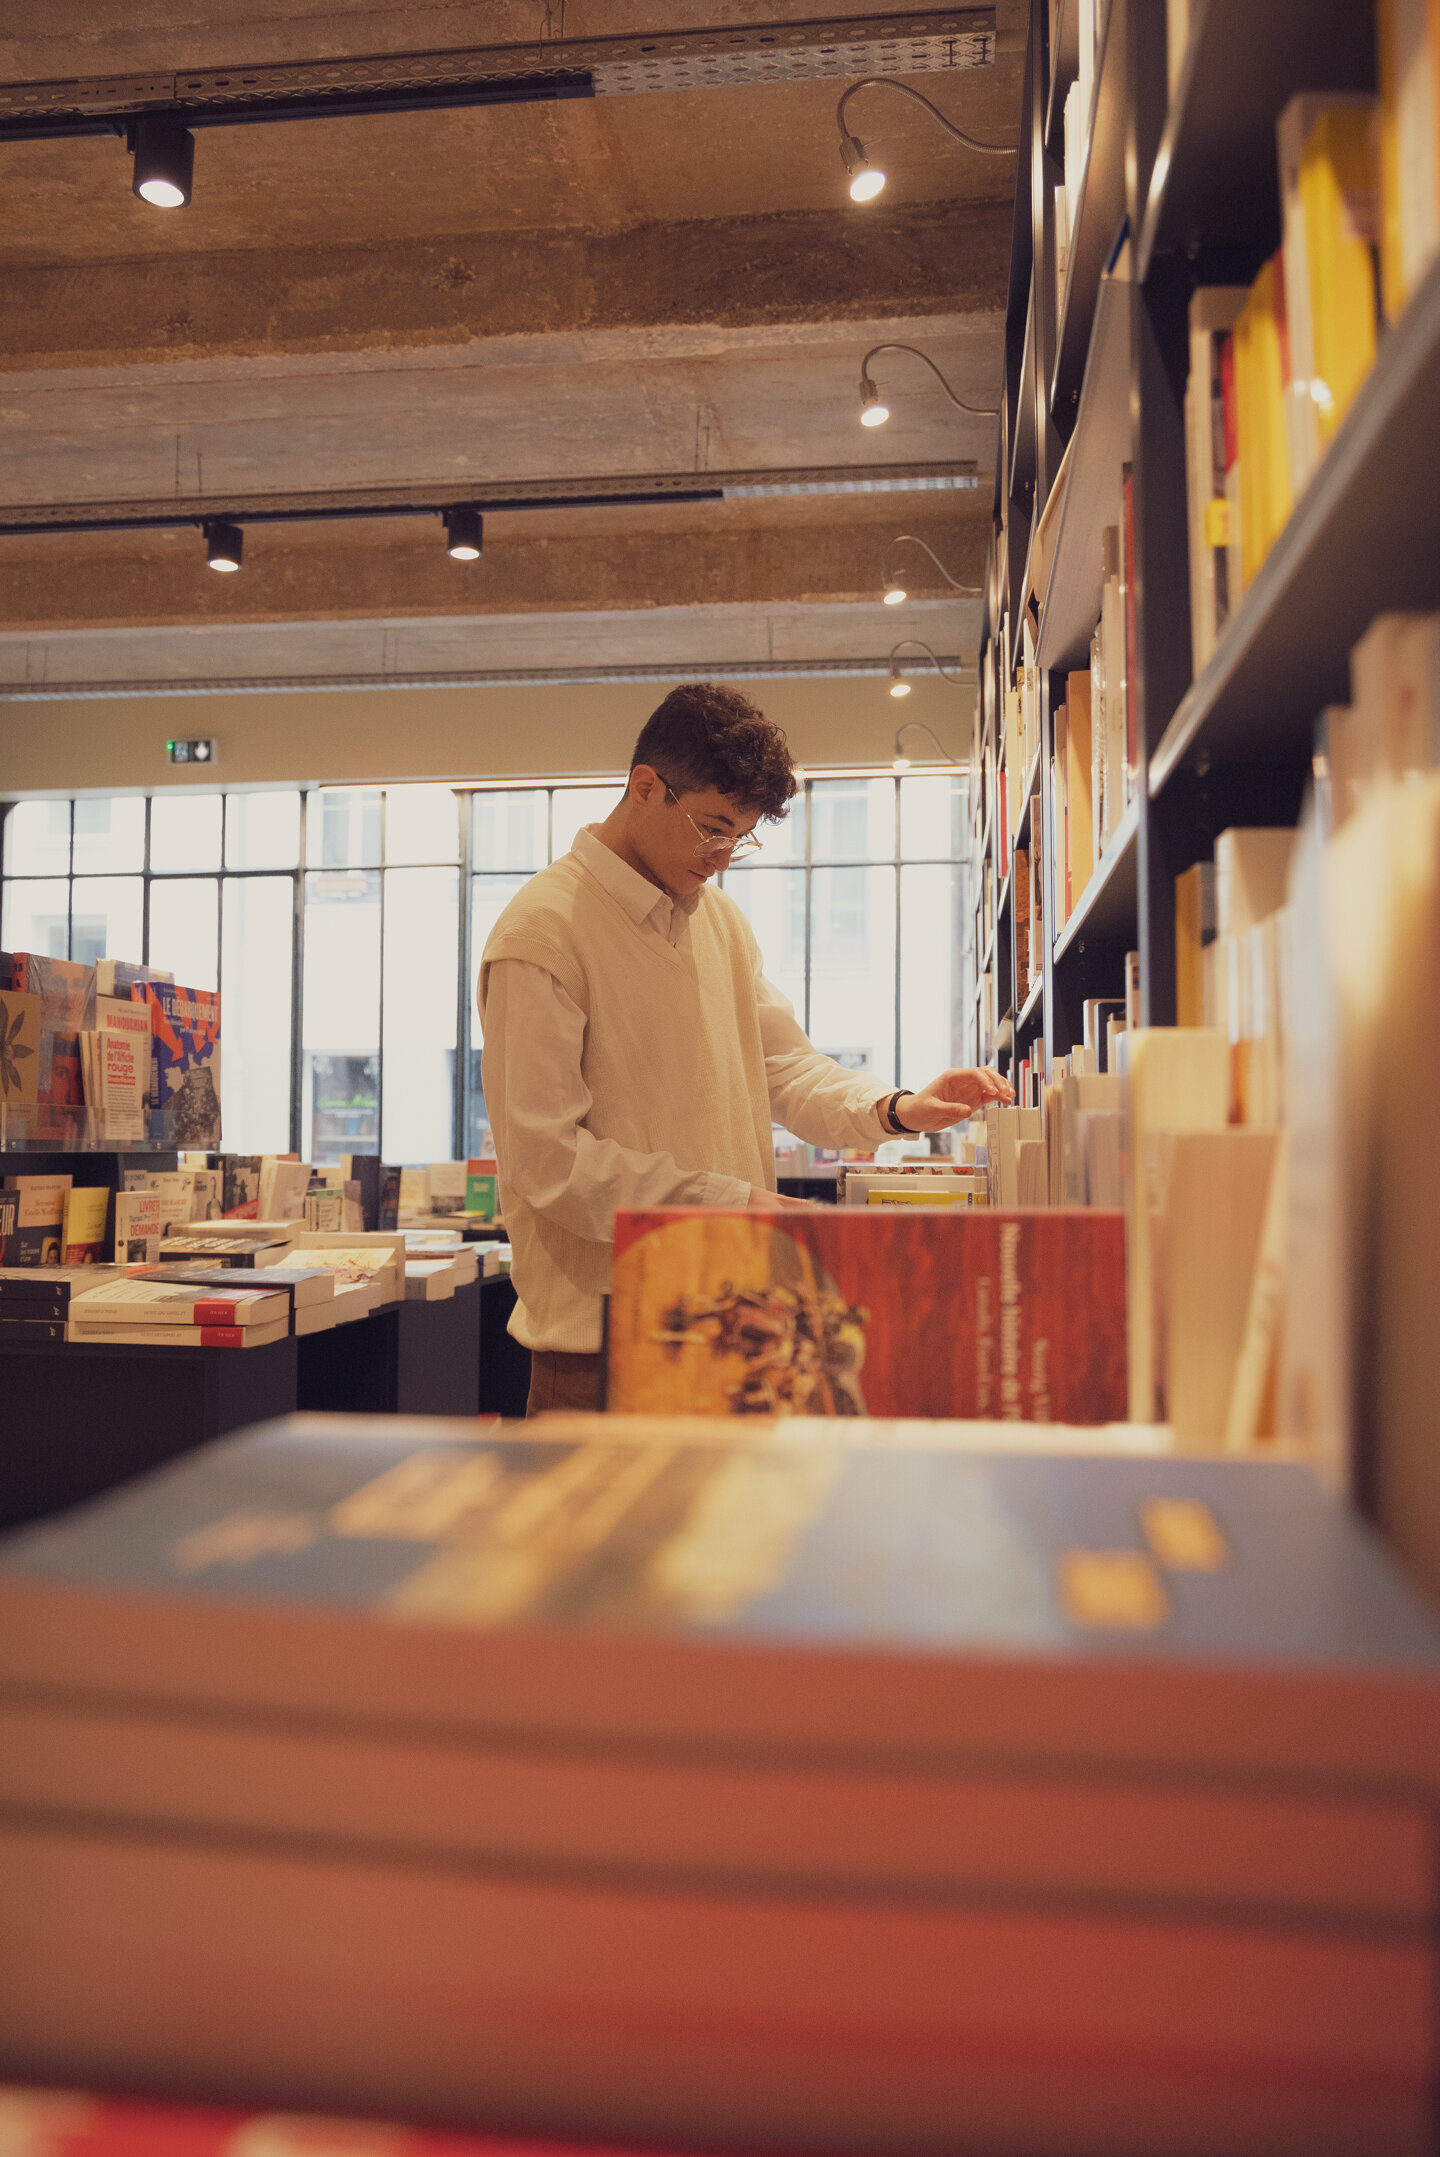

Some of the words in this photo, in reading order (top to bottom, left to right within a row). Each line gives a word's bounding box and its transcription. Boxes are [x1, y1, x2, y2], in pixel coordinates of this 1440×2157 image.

[163, 997, 171, 1016] LE
[108, 1063, 134, 1076] rouge
[139, 1200, 160, 1213] LIVRER
[0, 1204, 15, 1236] UR
[130, 1223, 160, 1237] DEMANDE
